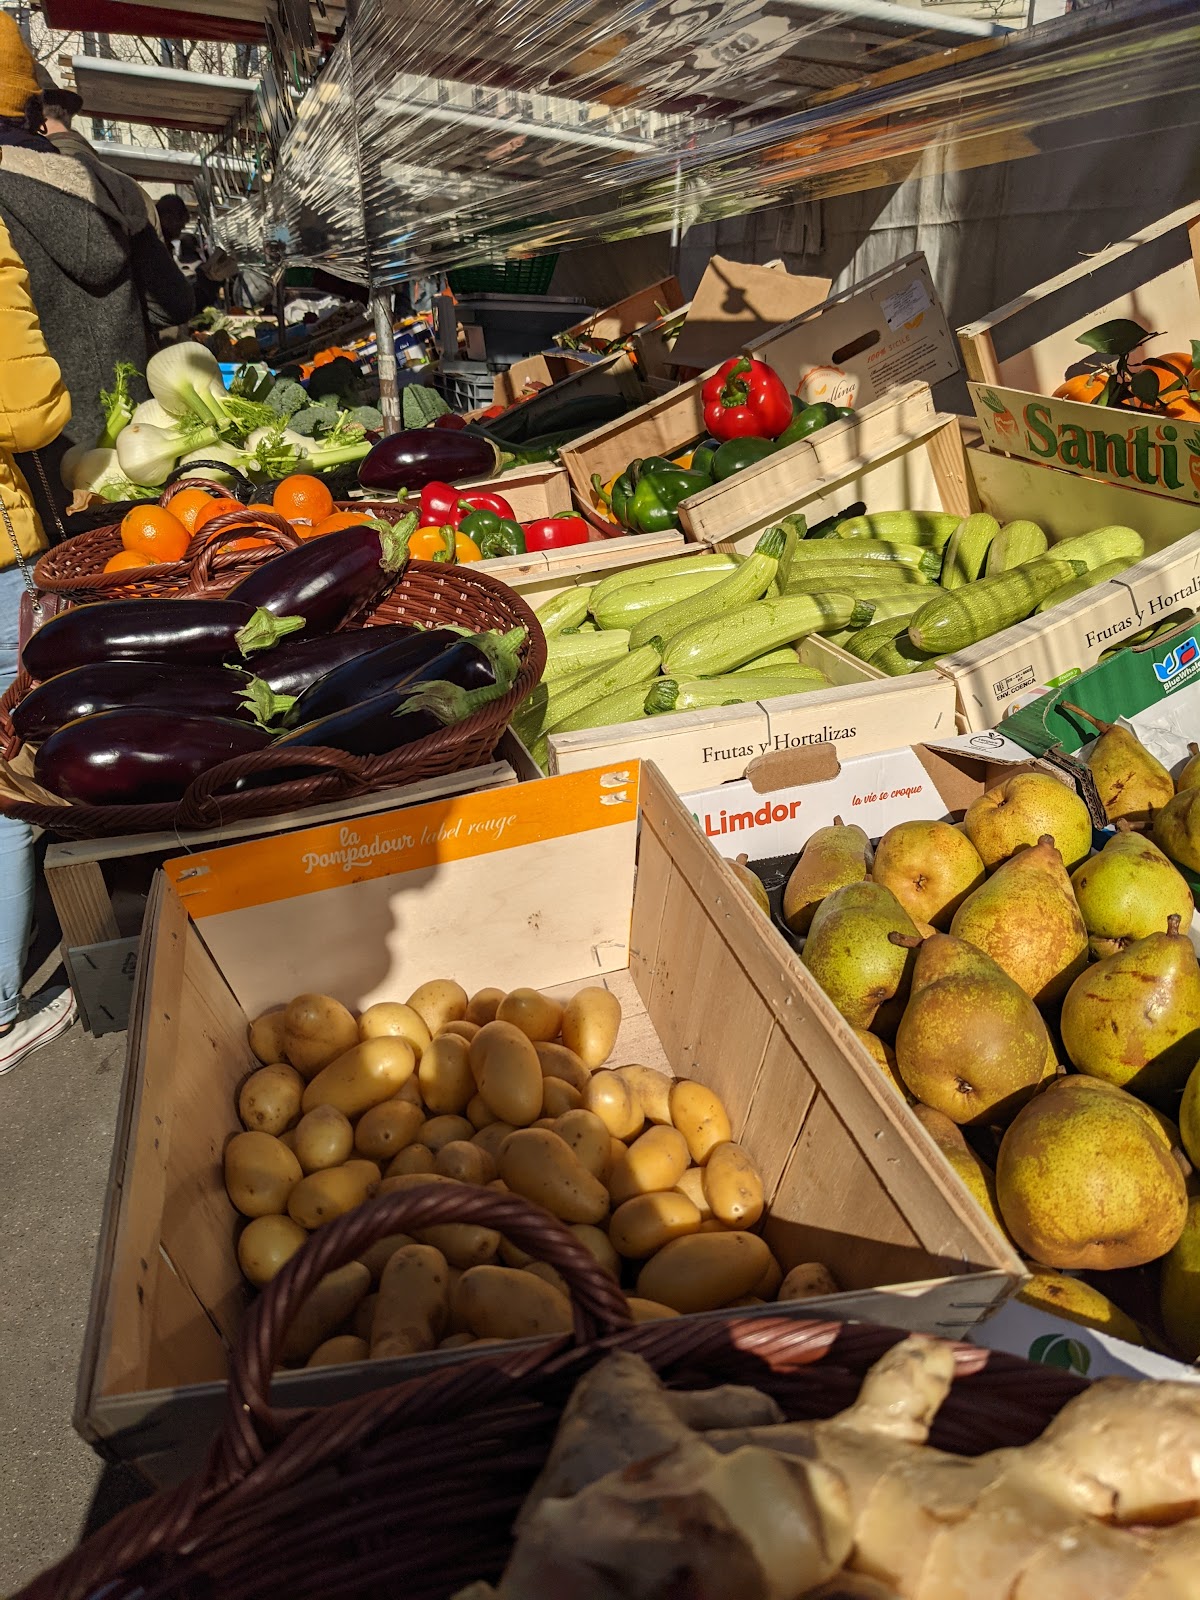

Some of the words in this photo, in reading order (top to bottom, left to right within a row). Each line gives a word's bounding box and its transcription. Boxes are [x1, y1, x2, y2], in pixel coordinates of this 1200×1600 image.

[867, 347, 887, 363] 100%
[888, 334, 911, 351] SICILE
[1022, 402, 1185, 490] Santi
[1084, 616, 1133, 649] Frutas
[1136, 609, 1145, 627] y
[702, 743, 754, 764] Frutas
[758, 742, 768, 756] y
[773, 725, 857, 752] Hortalizas
[852, 795, 862, 807] la
[864, 789, 878, 803] vie
[878, 788, 889, 801] se
[890, 784, 923, 800] croque
[339, 826, 361, 847] la
[704, 801, 802, 838] Limdor
[301, 834, 415, 874] Pompadour
[419, 818, 463, 847] label
[467, 814, 517, 841] rouge
